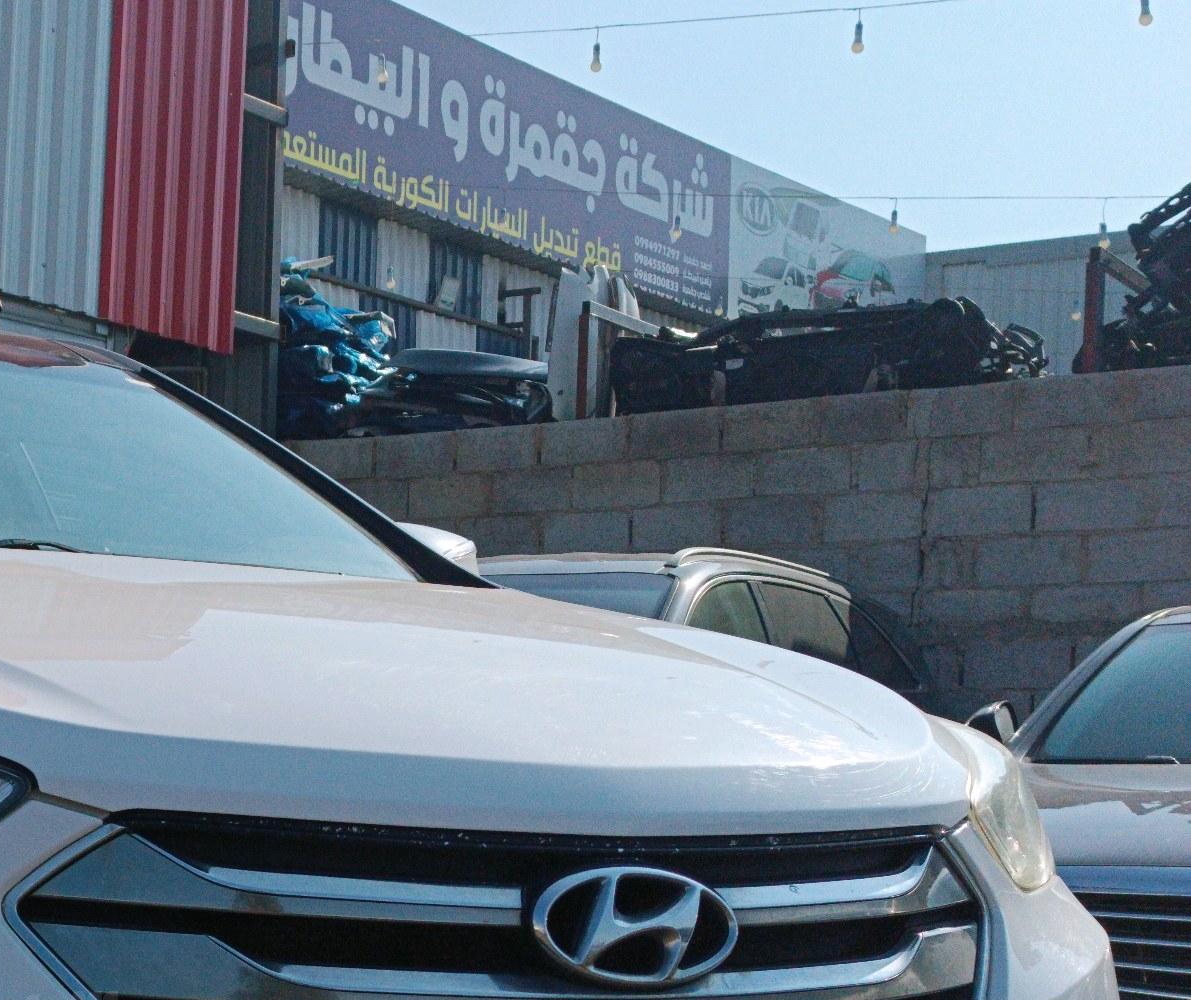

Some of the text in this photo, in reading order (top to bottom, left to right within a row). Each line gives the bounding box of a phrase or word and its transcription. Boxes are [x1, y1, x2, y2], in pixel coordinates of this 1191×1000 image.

[440, 79, 469, 162] و
[480, 74, 606, 214] جقمرة
[373, 155, 449, 209] الكورية
[615, 133, 714, 238] شركة
[456, 188, 528, 240] السيارات
[533, 215, 580, 262] تبديل
[584, 236, 621, 272] قطع
